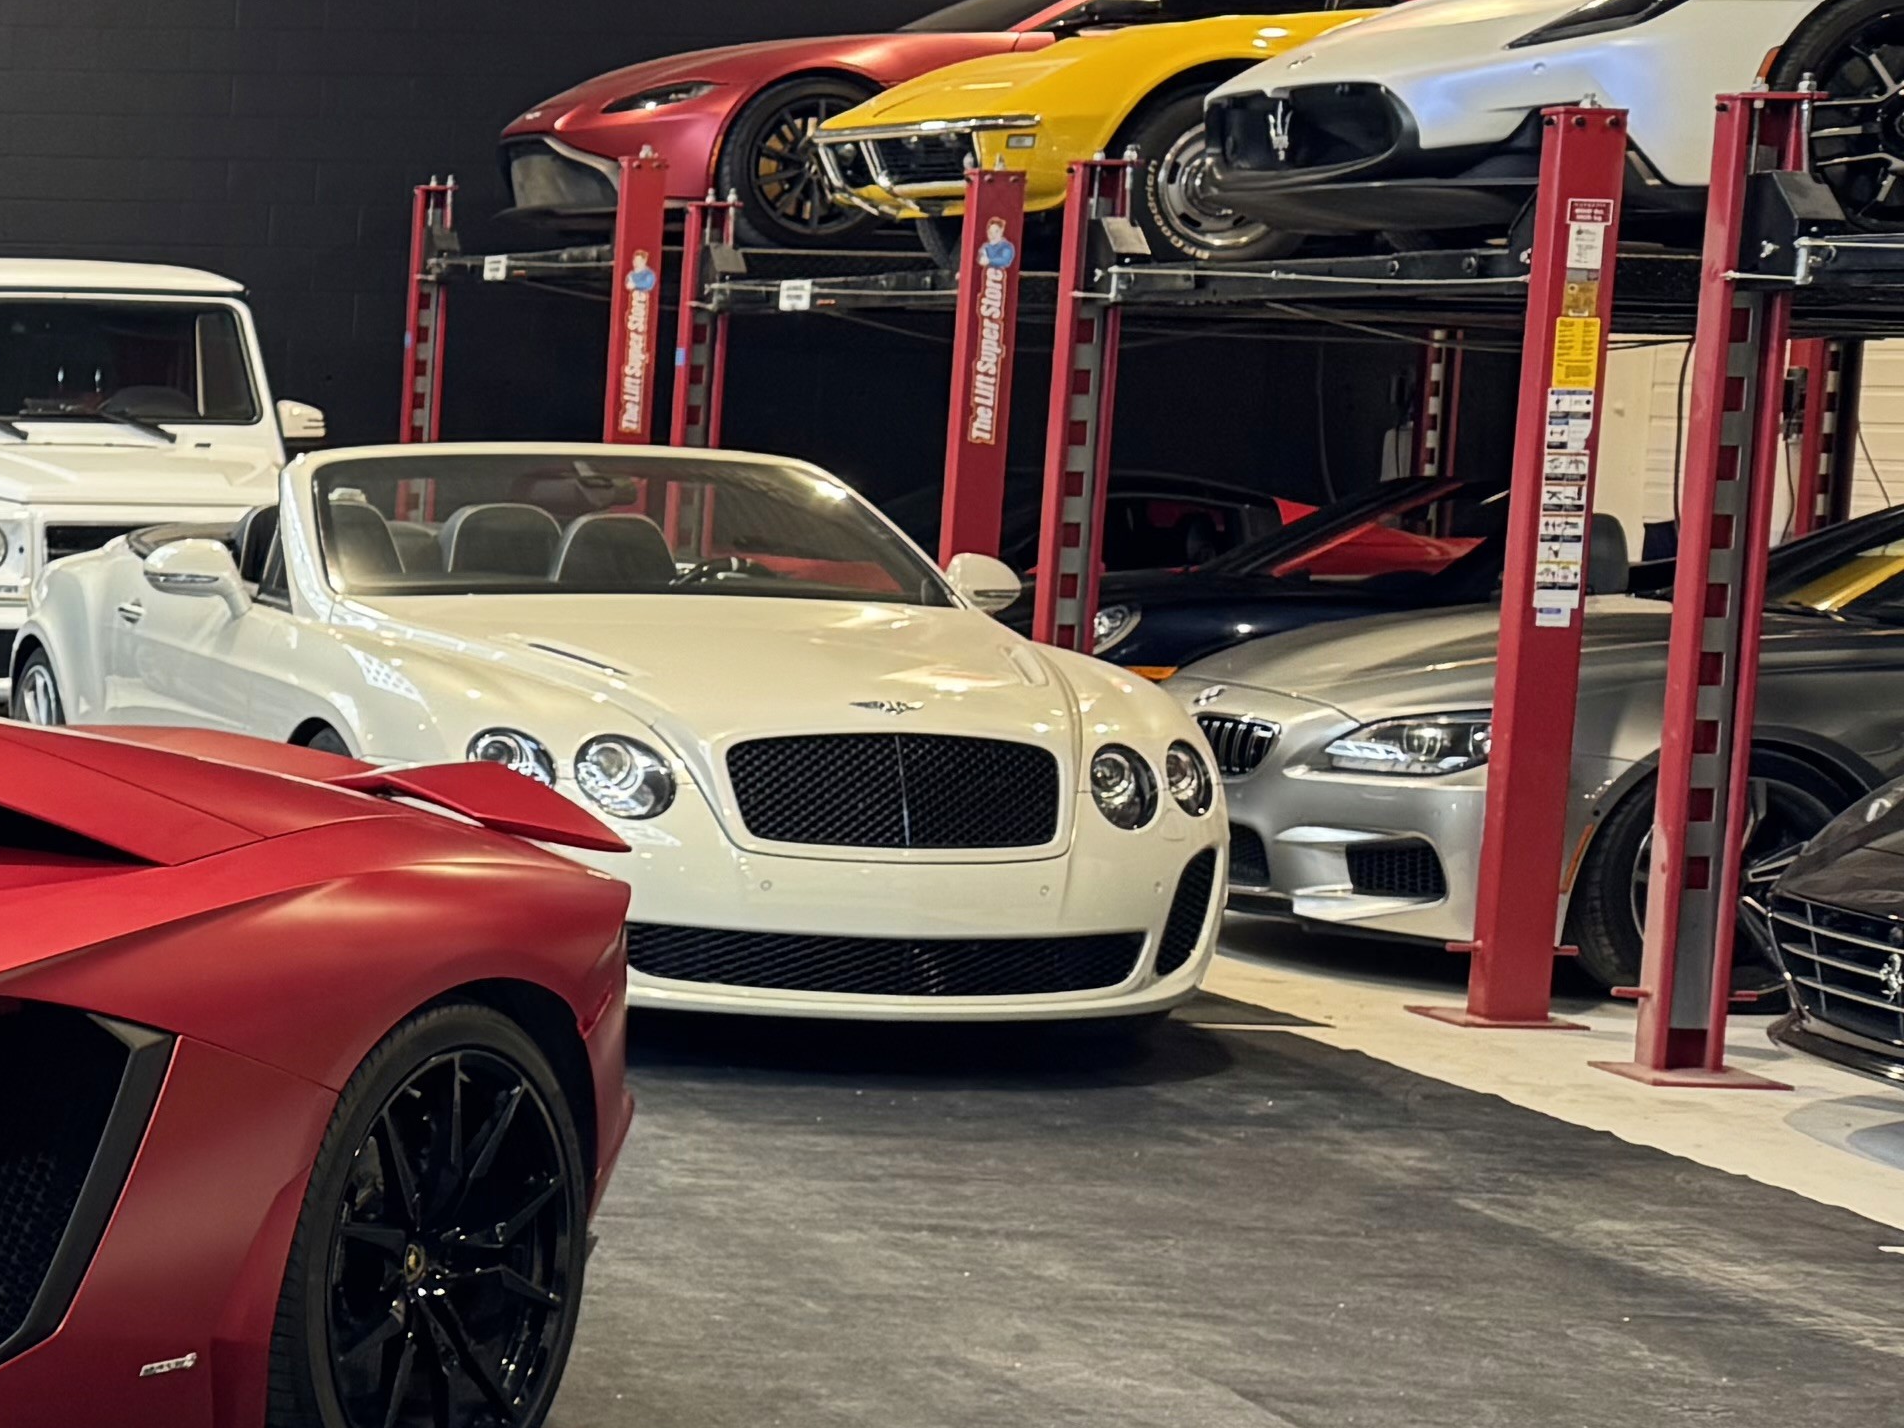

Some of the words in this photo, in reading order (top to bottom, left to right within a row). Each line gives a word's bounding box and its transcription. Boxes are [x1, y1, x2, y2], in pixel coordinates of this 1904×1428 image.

[980, 267, 1003, 320] Store
[976, 319, 1001, 375] Super
[974, 375, 996, 407] Lift
[972, 406, 993, 441] The
